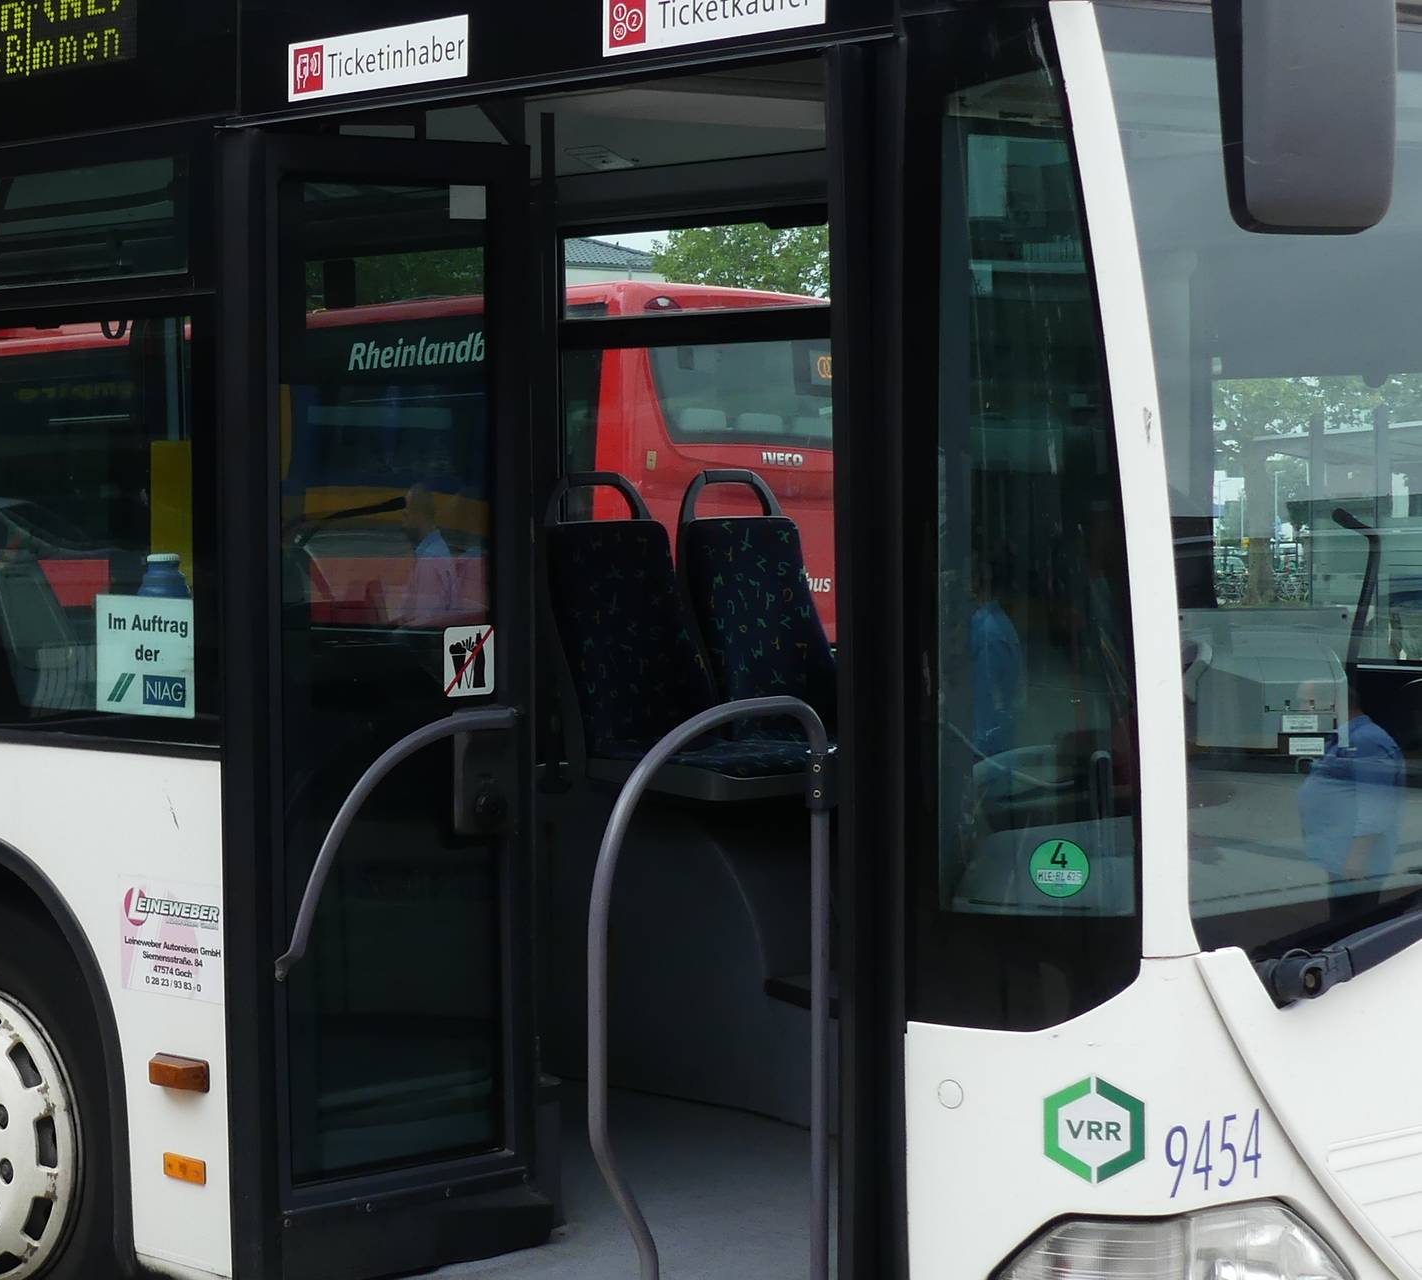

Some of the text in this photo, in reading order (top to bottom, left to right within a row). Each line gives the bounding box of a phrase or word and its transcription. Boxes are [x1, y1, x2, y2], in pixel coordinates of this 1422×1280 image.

[328, 36, 465, 79] Ticketinhaber
[762, 451, 803, 467] IVECO
[108, 612, 188, 638] Im Auftrag
[135, 644, 160, 661] der
[146, 679, 184, 702] NIAG
[1050, 842, 1068, 868] 4
[124, 936, 221, 958] Leineweber Autoreisen GmbH
[153, 965, 193, 979] 47574 Goch
[194, 958, 203, 967] 84
[1066, 1119, 1122, 1141] VRR
[1164, 1108, 1262, 1198] 9454
